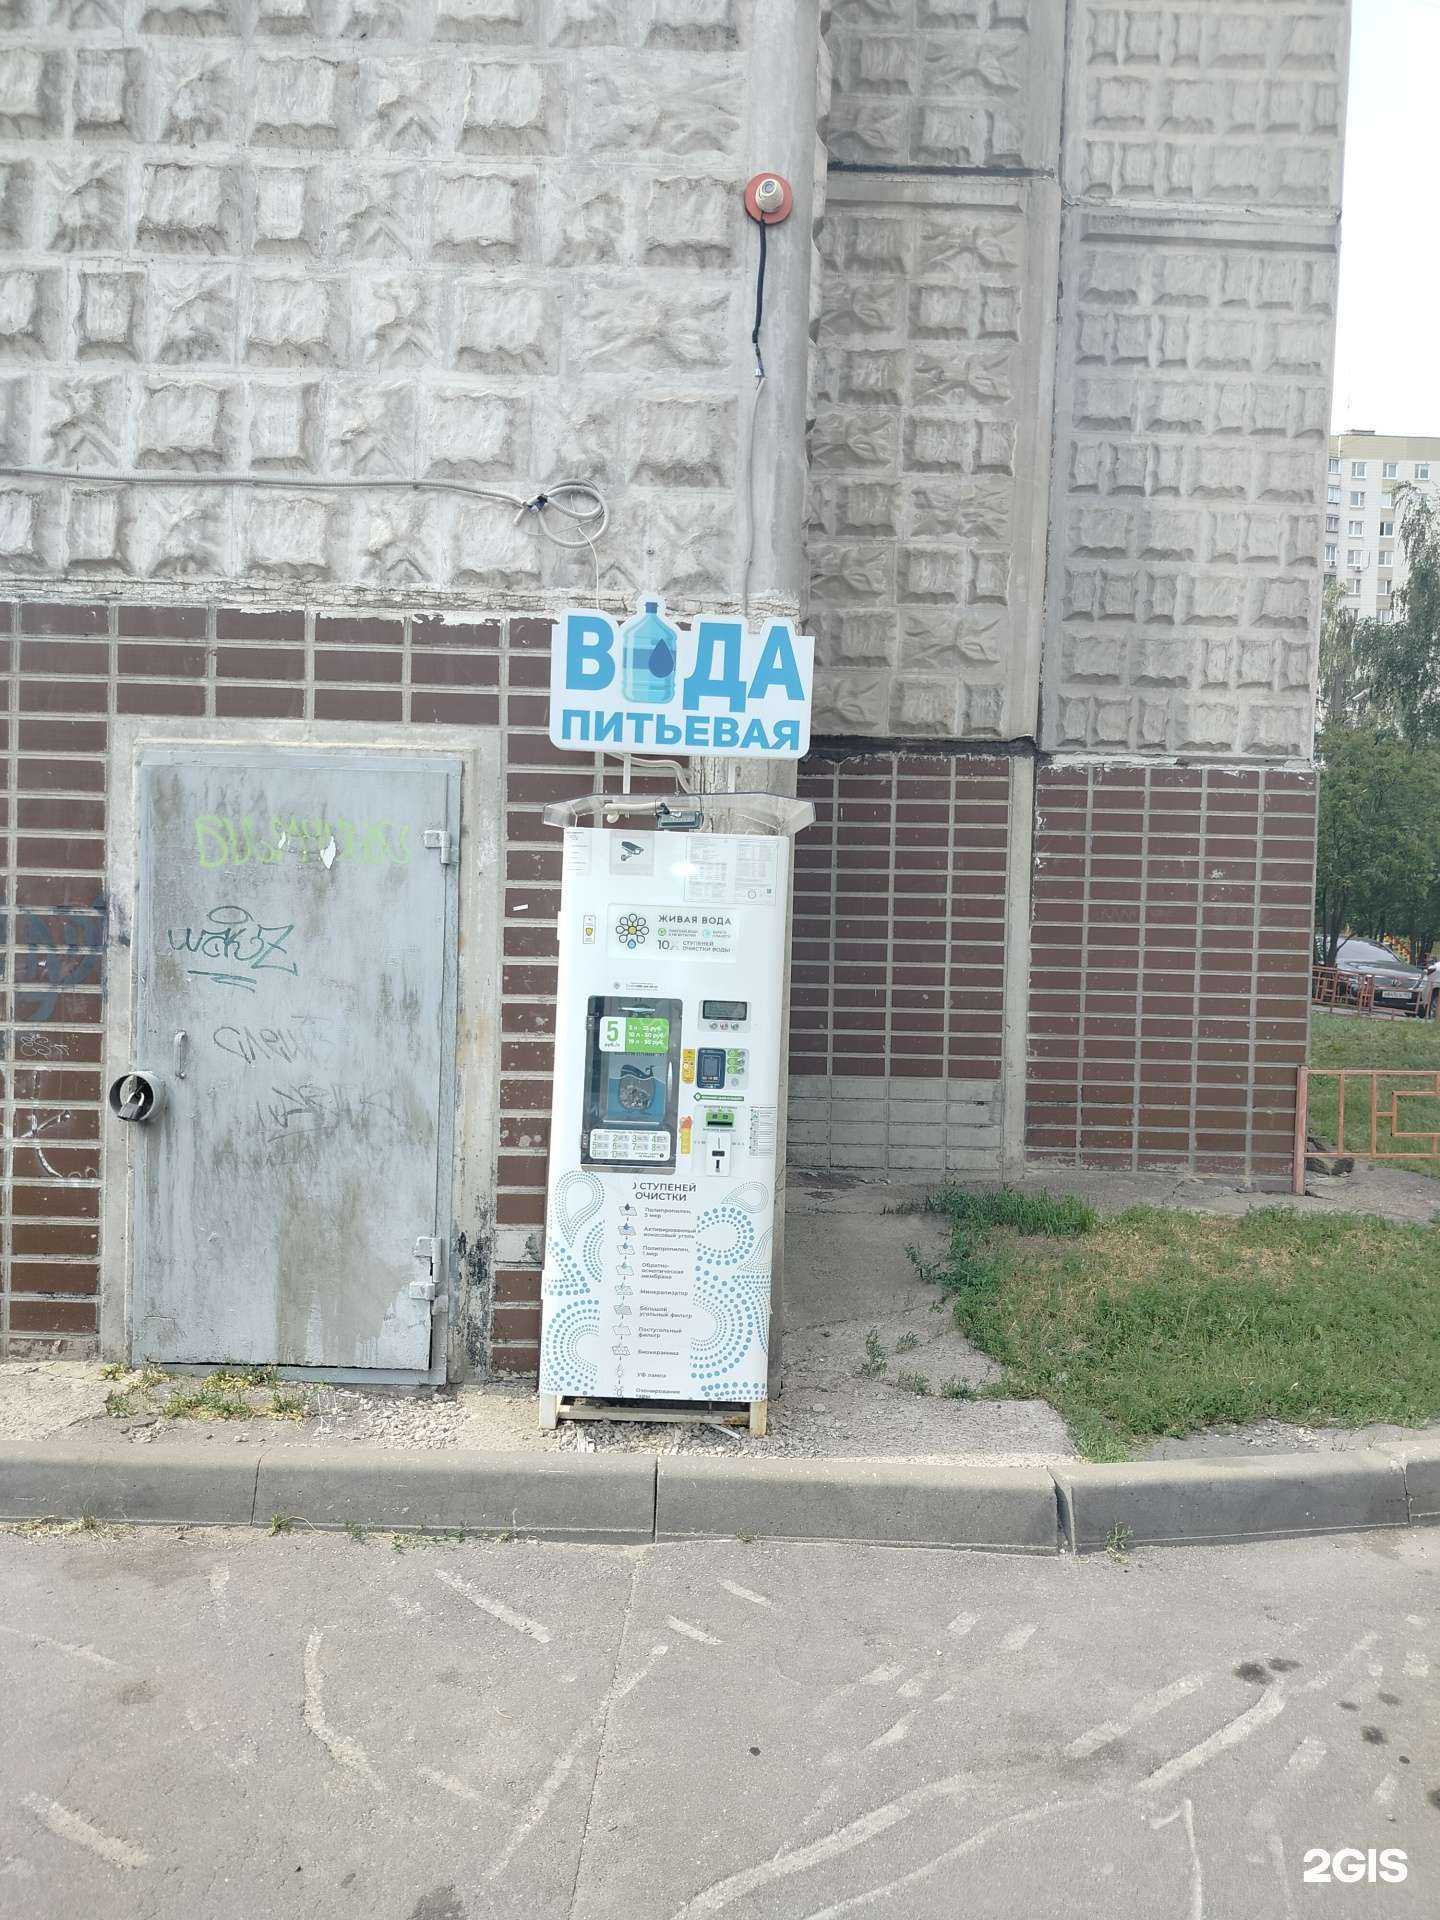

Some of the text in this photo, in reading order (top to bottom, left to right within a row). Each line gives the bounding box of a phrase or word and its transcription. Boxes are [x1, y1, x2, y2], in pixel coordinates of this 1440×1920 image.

[561, 709, 801, 751] ПИТЬЕВАЯ
[658, 914, 732, 926] ЖИВАЯ ВОДА
[657, 939, 670, 950] 10
[606, 1020, 619, 1042] 5
[640, 1182, 697, 1192] СТУПЕНЕЙ
[635, 1192, 687, 1201] ОЧИСТКИ
